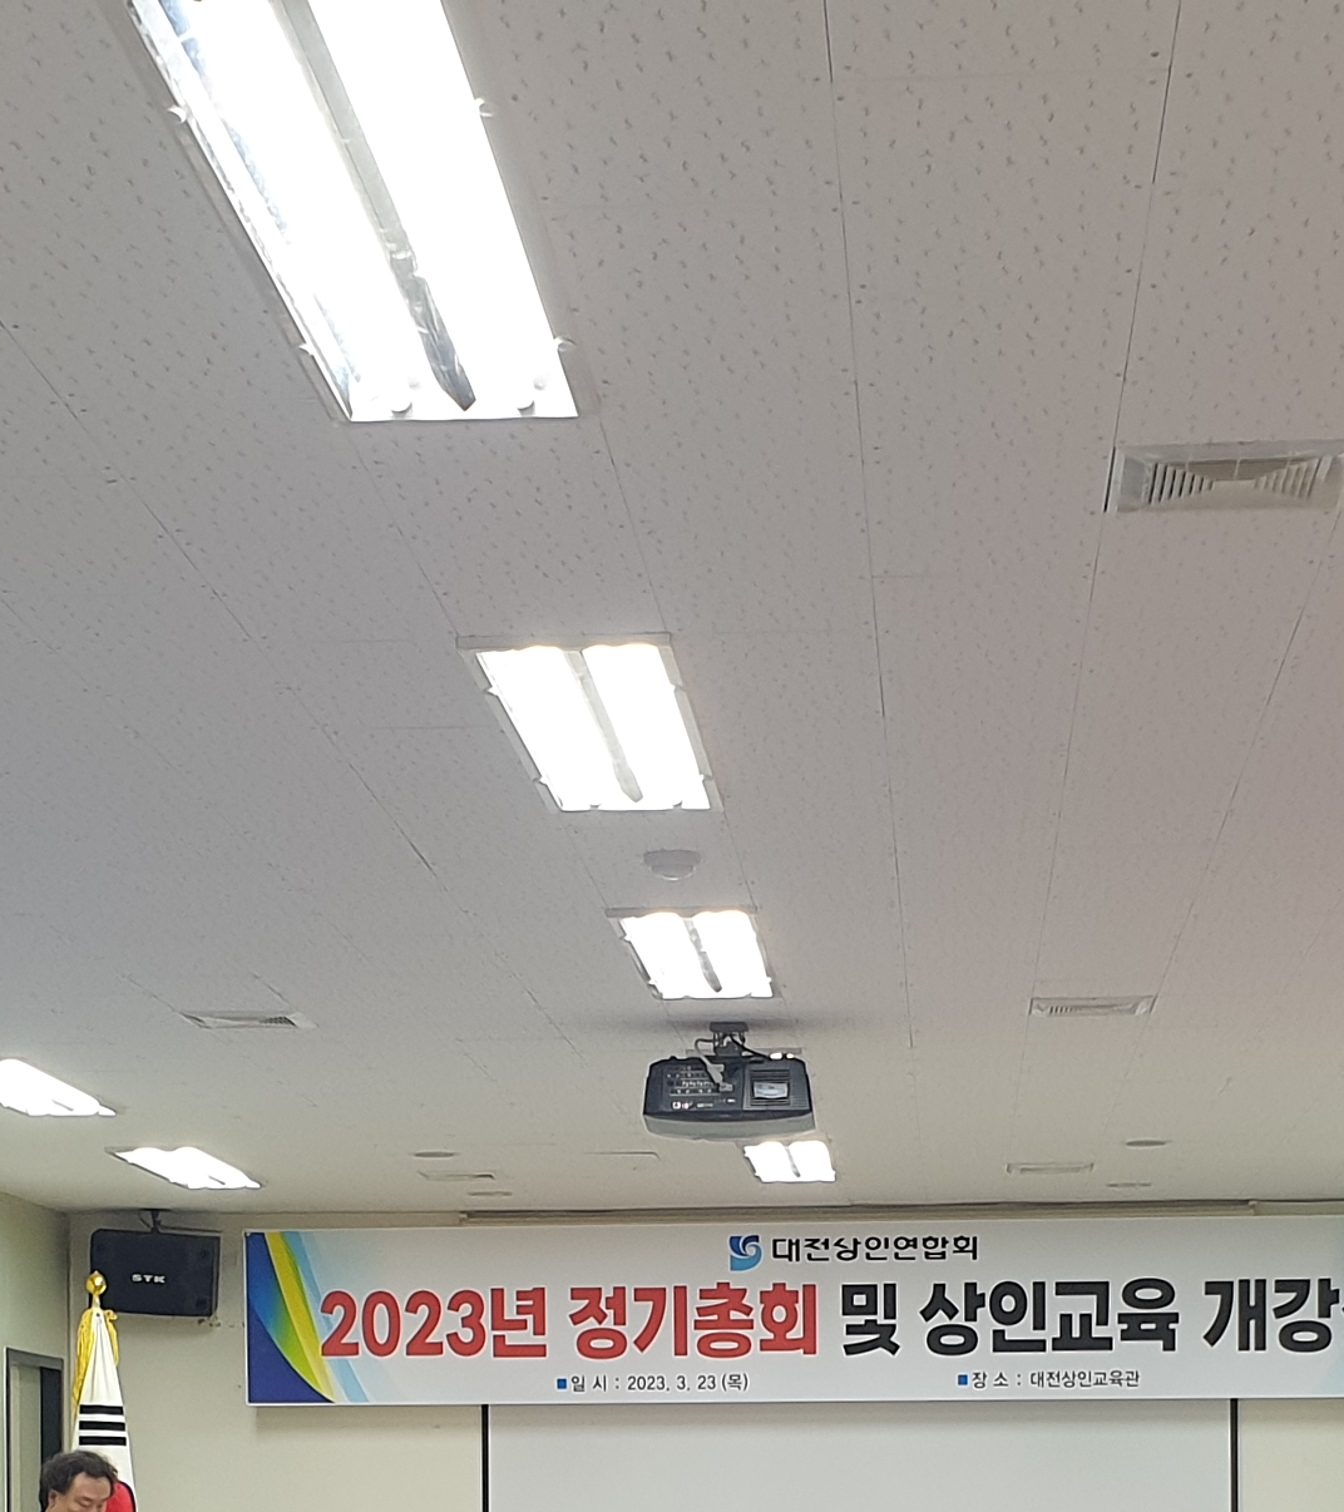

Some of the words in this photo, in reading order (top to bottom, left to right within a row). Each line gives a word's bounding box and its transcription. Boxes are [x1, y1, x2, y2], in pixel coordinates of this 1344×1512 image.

[771, 1235, 979, 1263] 대전상인연합회
[131, 1273, 166, 1284] STK
[320, 1286, 548, 1359] 2023년
[569, 1281, 817, 1359] 정기총회
[840, 1282, 901, 1356] 및
[919, 1276, 1180, 1355] 상인교육
[627, 1375, 670, 1391] 2023.
[676, 1375, 690, 1391] 3.
[1030, 1369, 1141, 1388] 대전상인교육관
